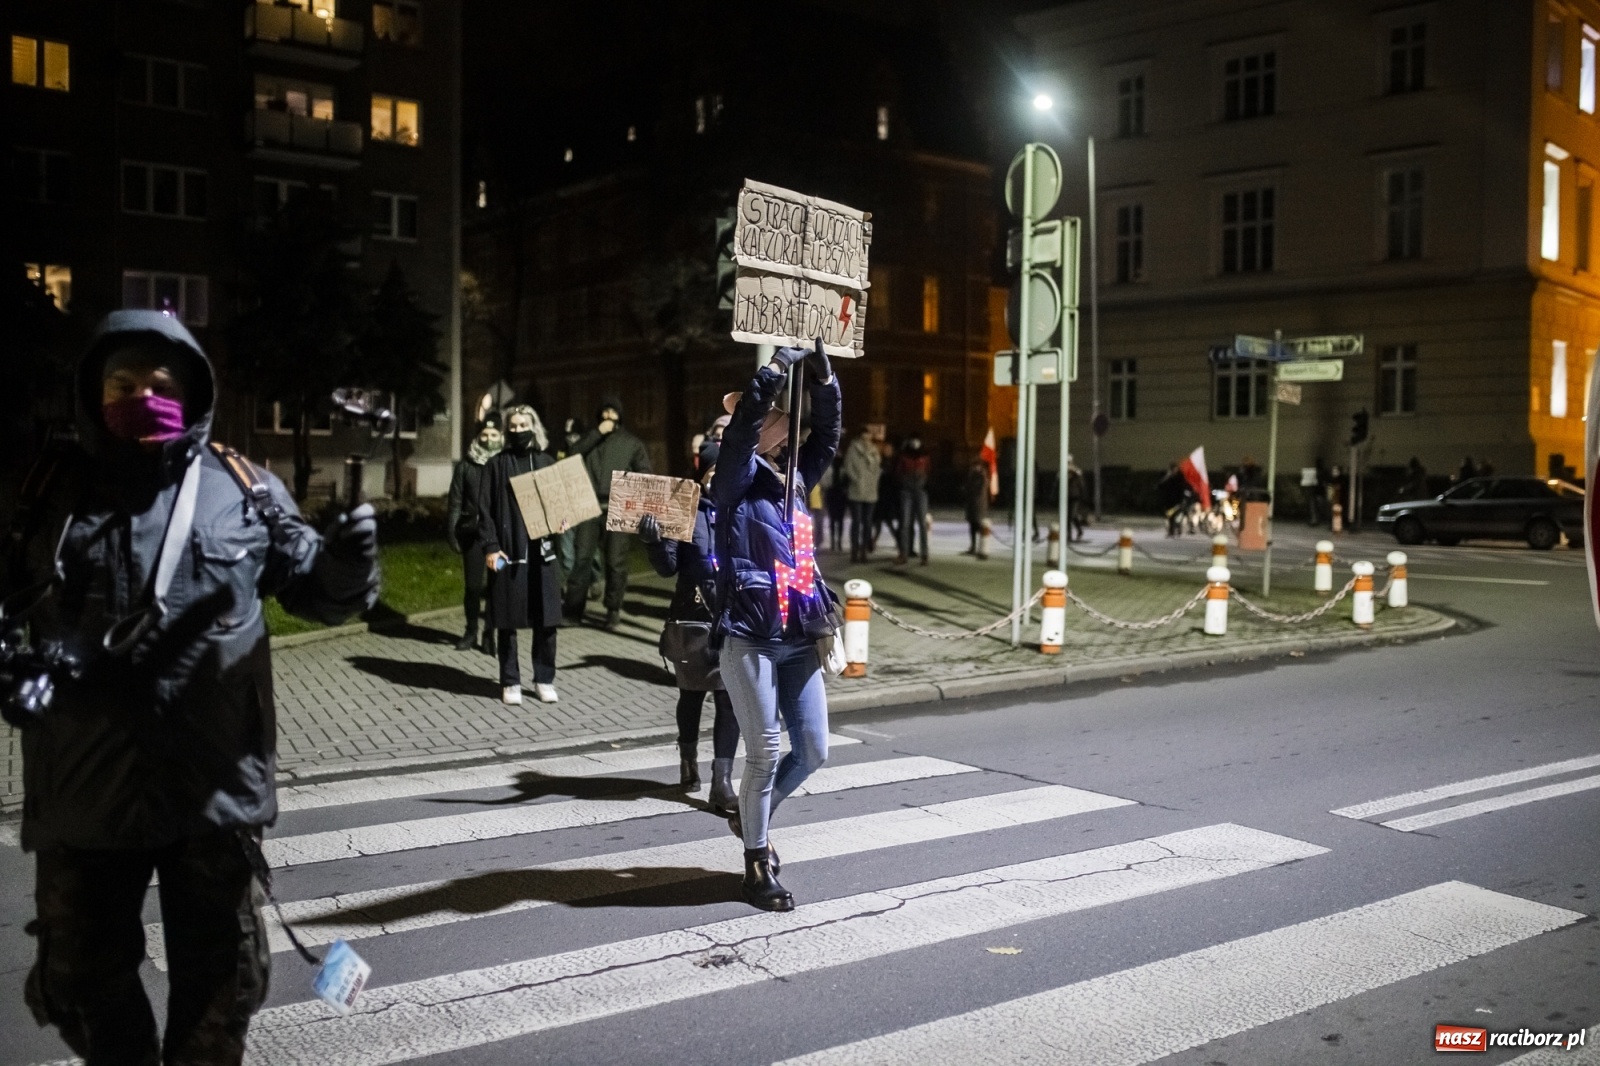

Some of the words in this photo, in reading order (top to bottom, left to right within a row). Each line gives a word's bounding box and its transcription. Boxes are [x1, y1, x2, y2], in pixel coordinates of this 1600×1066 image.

[750, 197, 806, 233] STRACH
[743, 228, 804, 267] KACZORA
[812, 241, 859, 278] LEPSZY
[792, 278, 811, 300] OD
[736, 293, 836, 342] WIBRATORA
[625, 500, 637, 512] DO
[335, 961, 359, 1003] PRESS
